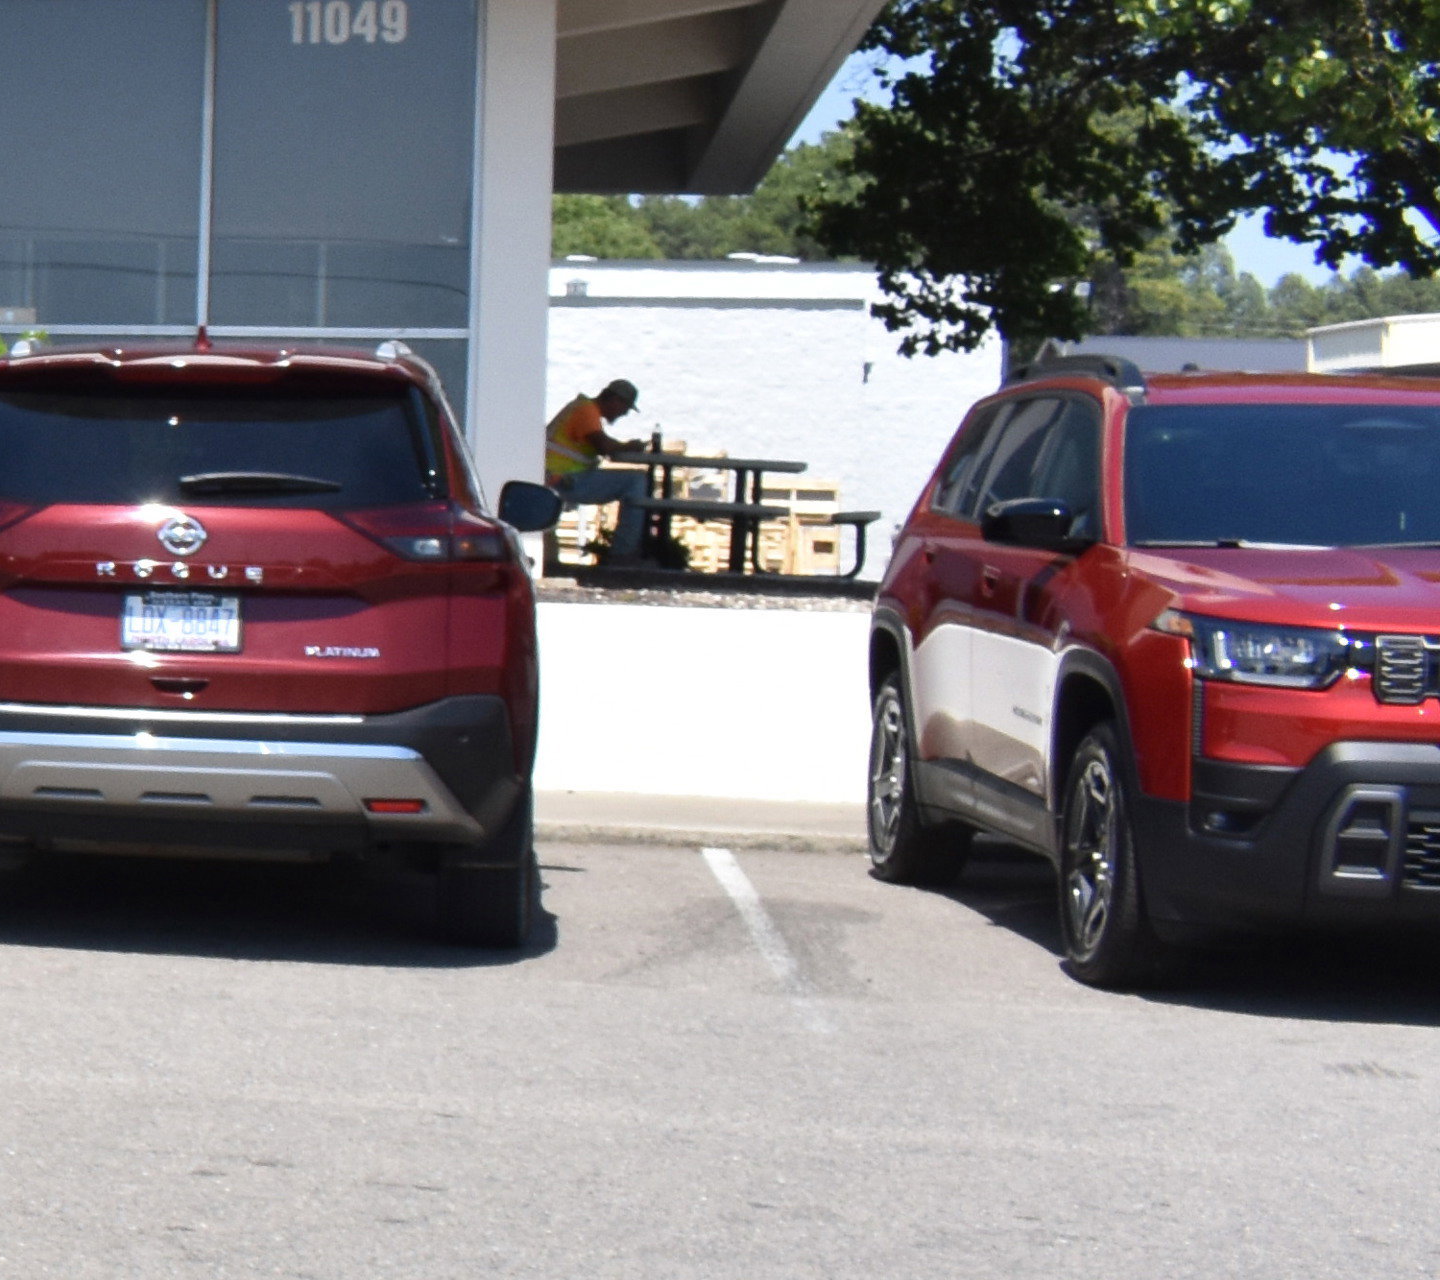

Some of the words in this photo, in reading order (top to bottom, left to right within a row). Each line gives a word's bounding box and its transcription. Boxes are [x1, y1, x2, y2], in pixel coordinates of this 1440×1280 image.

[288, 0, 408, 43] 11049
[96, 560, 264, 583] ROGUE
[304, 645, 380, 658] PLATINUM
